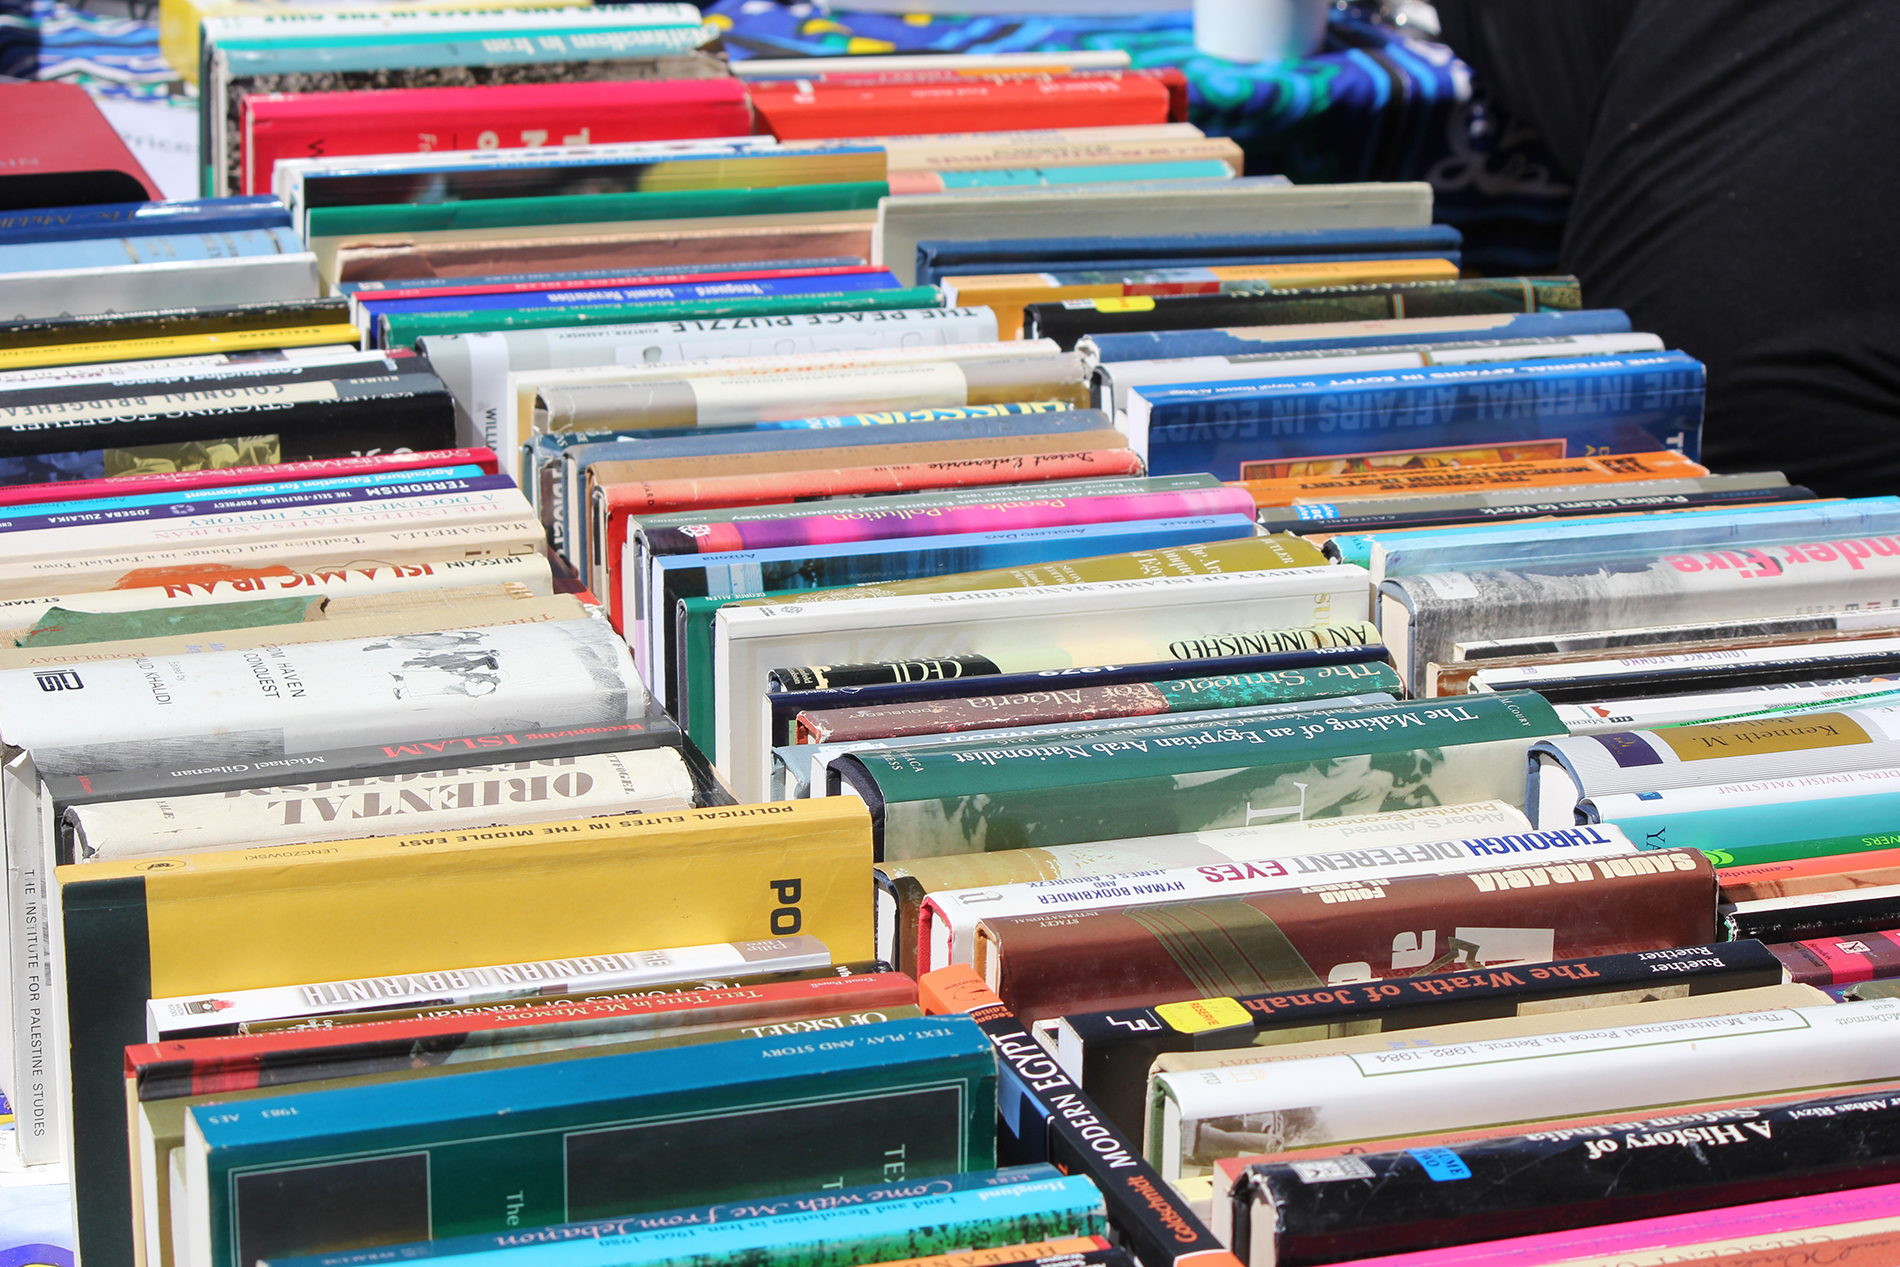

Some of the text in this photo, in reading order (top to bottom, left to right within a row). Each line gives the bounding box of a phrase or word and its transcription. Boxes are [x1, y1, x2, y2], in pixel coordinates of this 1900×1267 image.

[670, 306, 979, 333] THE PEACE PUZZLE
[164, 385, 285, 404] COLONIAL
[1468, 374, 1634, 421] INTERNAL
[1272, 398, 1306, 435] IN
[1318, 388, 1460, 433] AFFAIRS
[927, 451, 1094, 472] Desert Enterprise
[183, 485, 272, 500] Development
[301, 475, 371, 489] Education
[48, 480, 469, 524] TERRORISM THE SELF-FULFILLING PROPHECY JOSEBA ZULAIKA
[1087, 487, 1145, 499] History
[299, 496, 471, 518] DOCUMENTARY
[832, 508, 942, 523] Pollution
[897, 501, 955, 511] Empire
[982, 499, 1067, 514] People
[1478, 494, 1690, 516] Putting Islam to Work
[154, 504, 501, 540] THE UNITED STATES AND IRAN
[188, 512, 286, 527] HISTORY
[391, 522, 528, 541] MAGNARELLA
[161, 552, 177, 561] in
[184, 546, 243, 559] Change
[249, 542, 277, 554] and
[702, 552, 756, 562] Arizona
[33, 561, 74, 571] Town
[80, 556, 144, 567] Turkish
[445, 556, 522, 569] HUSSAIN
[1662, 549, 1783, 579] Fire
[280, 563, 435, 588] ISLAMIC
[929, 568, 1327, 604] SURVEY OF ISLAMIC MANUSCRIPTS
[705, 594, 732, 602] ALLEN
[1168, 625, 1367, 662] AN UNFINISHED
[29, 652, 146, 665] DOUBLEDAY
[243, 652, 281, 699] CONQUEST
[277, 662, 306, 698] HAVEN
[143, 671, 172, 706] KHALIDI
[848, 663, 1381, 720] The Struggle For Algeria DOUBLEDAY
[1345, 711, 1427, 733] Making
[1431, 704, 1480, 722] The
[1153, 728, 1266, 749] Egyptian
[1264, 726, 1297, 739] an
[1300, 723, 1326, 740] of
[1691, 723, 1839, 748] Kenneth M.
[171, 723, 644, 778] Recognizing ISLAM Michael Gilsenan
[952, 744, 1092, 767] Nationalist
[1092, 740, 1150, 757] Arab
[1714, 779, 1795, 796] PALESTINE
[268, 772, 594, 827] ORIENTAL
[1412, 802, 1500, 821] Pukhtun
[1445, 811, 1506, 828] Akbar
[244, 806, 794, 861] POLITICAL ELITES IN THE MIDDLE EAST LENCZOWSKI
[1340, 821, 1420, 838] Ahmed
[1460, 827, 1612, 857] THROUGH
[1290, 841, 1465, 875] DIFFERENT
[1196, 859, 1290, 884] EYES
[1467, 852, 1698, 893] SAUDI ARABIA
[1036, 881, 1186, 905] HYMAN BOOKBINDER
[1093, 880, 1117, 888] AND
[1039, 917, 1080, 928] STACEY
[1637, 945, 1714, 964] Ruether
[1648, 957, 1726, 976] Ruether
[29, 975, 41, 1002] FOR
[300, 954, 635, 1007] IRANIAN LABYRINTH
[1242, 963, 1601, 1014] The Wrath of Jonah
[494, 989, 763, 1023] TELL THIS in MY MEMORY
[741, 1012, 889, 1038] OF ISRAEL
[1622, 1017, 1745, 1039] Multinational
[1748, 1013, 1786, 1026] The
[30, 1007, 44, 1077] PALESTINE
[1546, 1036, 1566, 1046] in
[1568, 1029, 1620, 1043] Force
[761, 1038, 855, 1059] AND STORY
[989, 1031, 1071, 1092] EGYPT
[32, 1083, 46, 1137] STUDIES
[1788, 1098, 1888, 1120] Abbas Rizvi
[1050, 1092, 1138, 1169] MODERN
[1583, 1120, 1774, 1160] A History of
[867, 1181, 954, 1202] Come
[505, 1190, 524, 1226] The
[729, 1203, 789, 1219] Me
[793, 1194, 863, 1214] with
[875, 1203, 908, 1213] and
[913, 1196, 957, 1209] Land
[638, 1205, 726, 1231] from
[749, 1220, 766, 1229] in
[770, 1206, 870, 1225] Revolution
[492, 1217, 635, 1248] Lebanon
